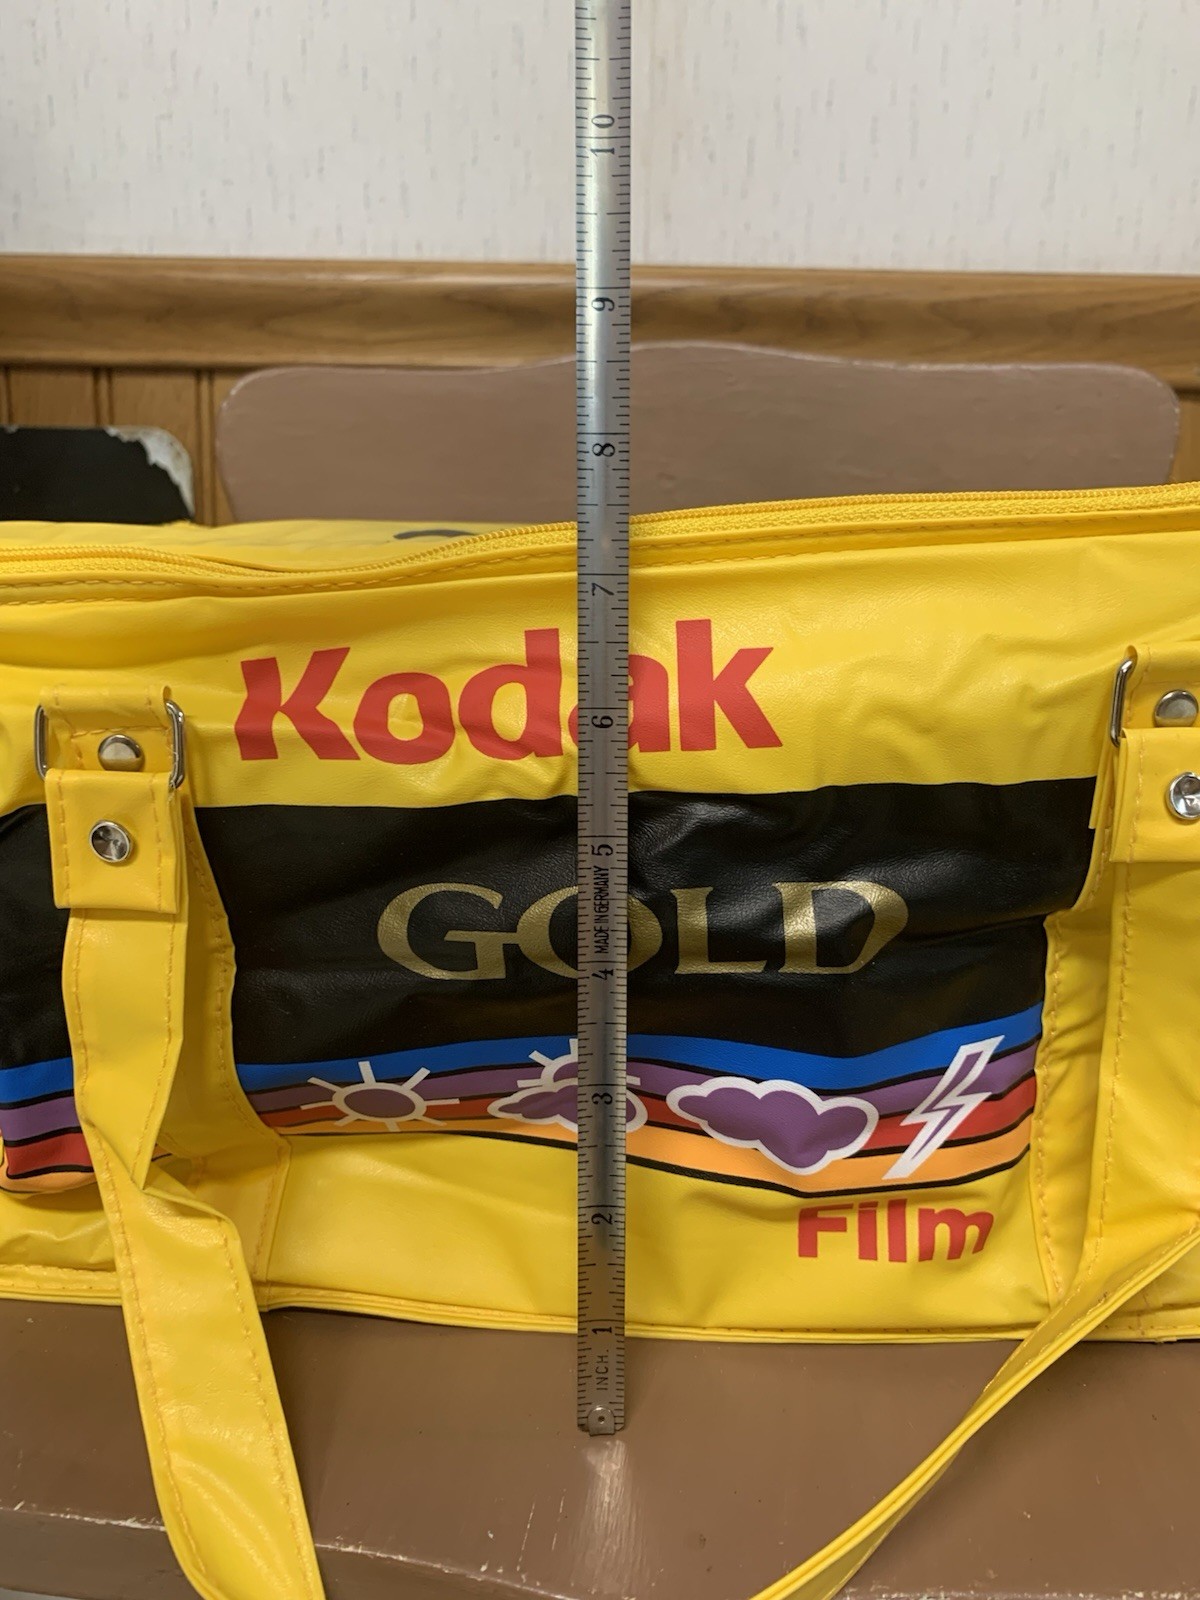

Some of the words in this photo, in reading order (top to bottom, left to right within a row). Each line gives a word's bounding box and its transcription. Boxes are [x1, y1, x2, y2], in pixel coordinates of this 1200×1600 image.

[590, 113, 616, 157] 10
[591, 296, 615, 312] 9
[592, 442, 616, 457] 8
[591, 582, 615, 597] 7
[233, 618, 784, 765] Kodak
[591, 715, 614, 729] 6
[591, 843, 614, 856] 5
[593, 865, 610, 913] GERMANY
[594, 914, 609, 924] IN
[376, 881, 909, 980] GOLD
[593, 926, 610, 954] MADE
[591, 968, 614, 981] 4
[591, 1092, 613, 1105] 3
[591, 1212, 613, 1226] 2
[797, 1198, 994, 1263] Film
[591, 1326, 613, 1335] 1
